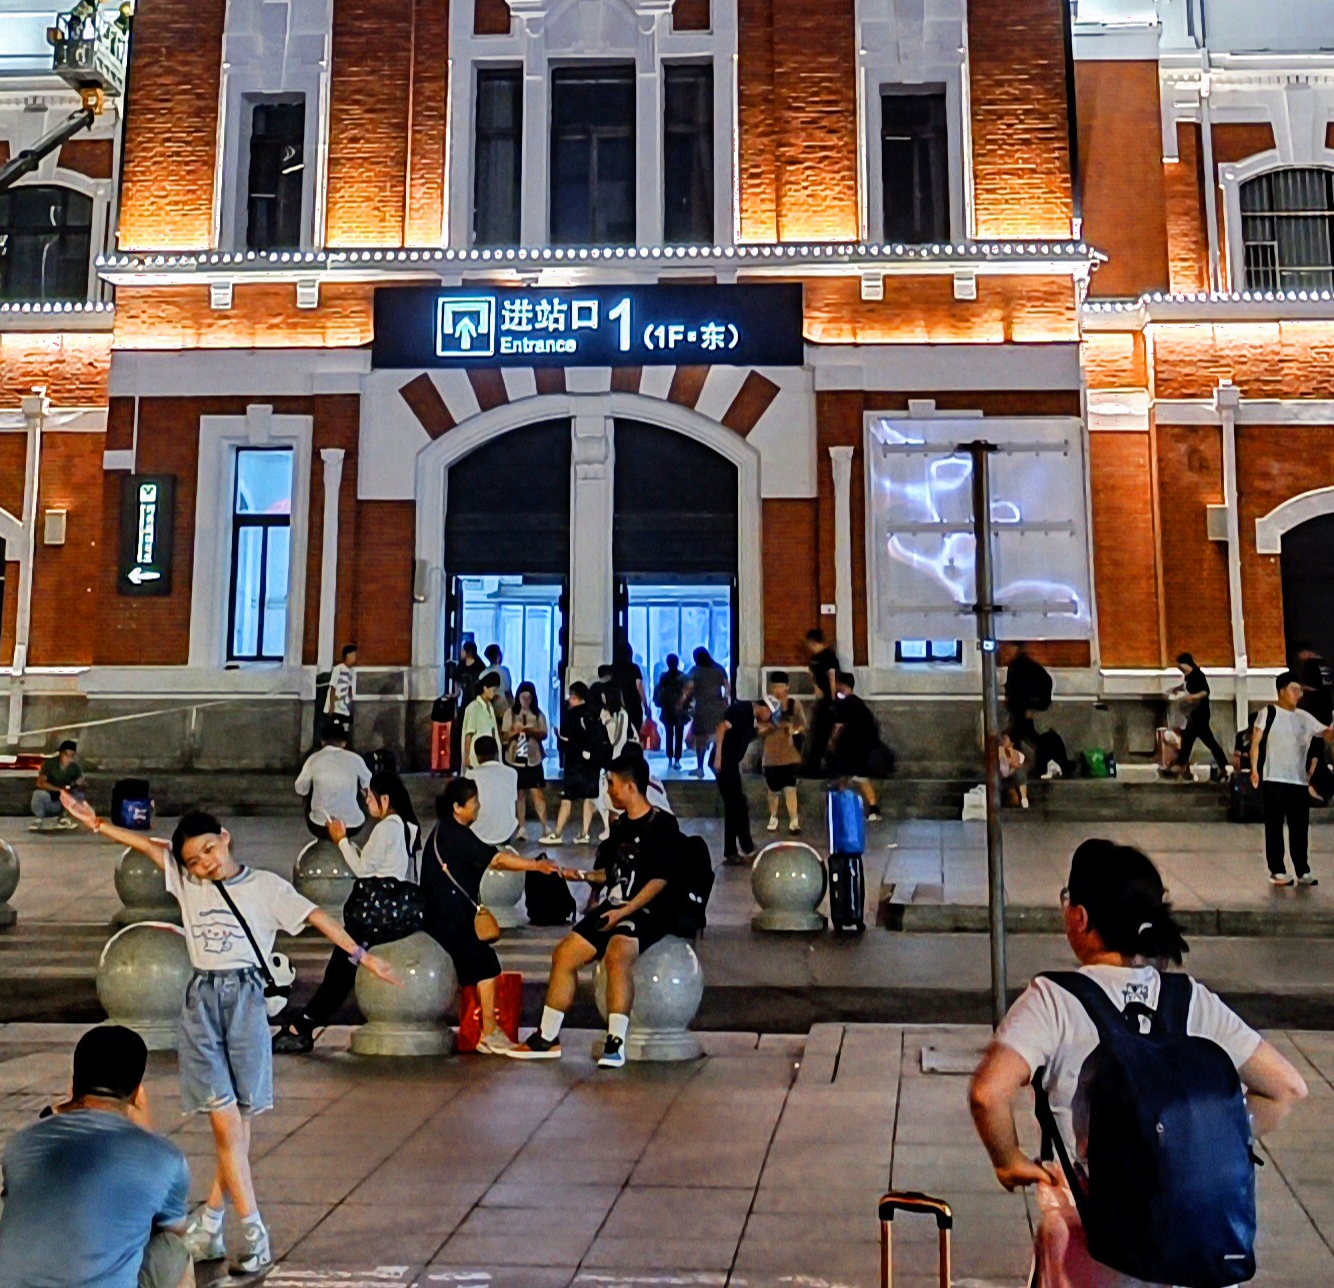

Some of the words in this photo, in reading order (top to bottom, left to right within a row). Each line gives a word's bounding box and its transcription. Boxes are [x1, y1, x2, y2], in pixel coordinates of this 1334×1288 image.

[500, 298, 600, 332] 进站口
[499, 337, 577, 354] Entrance
